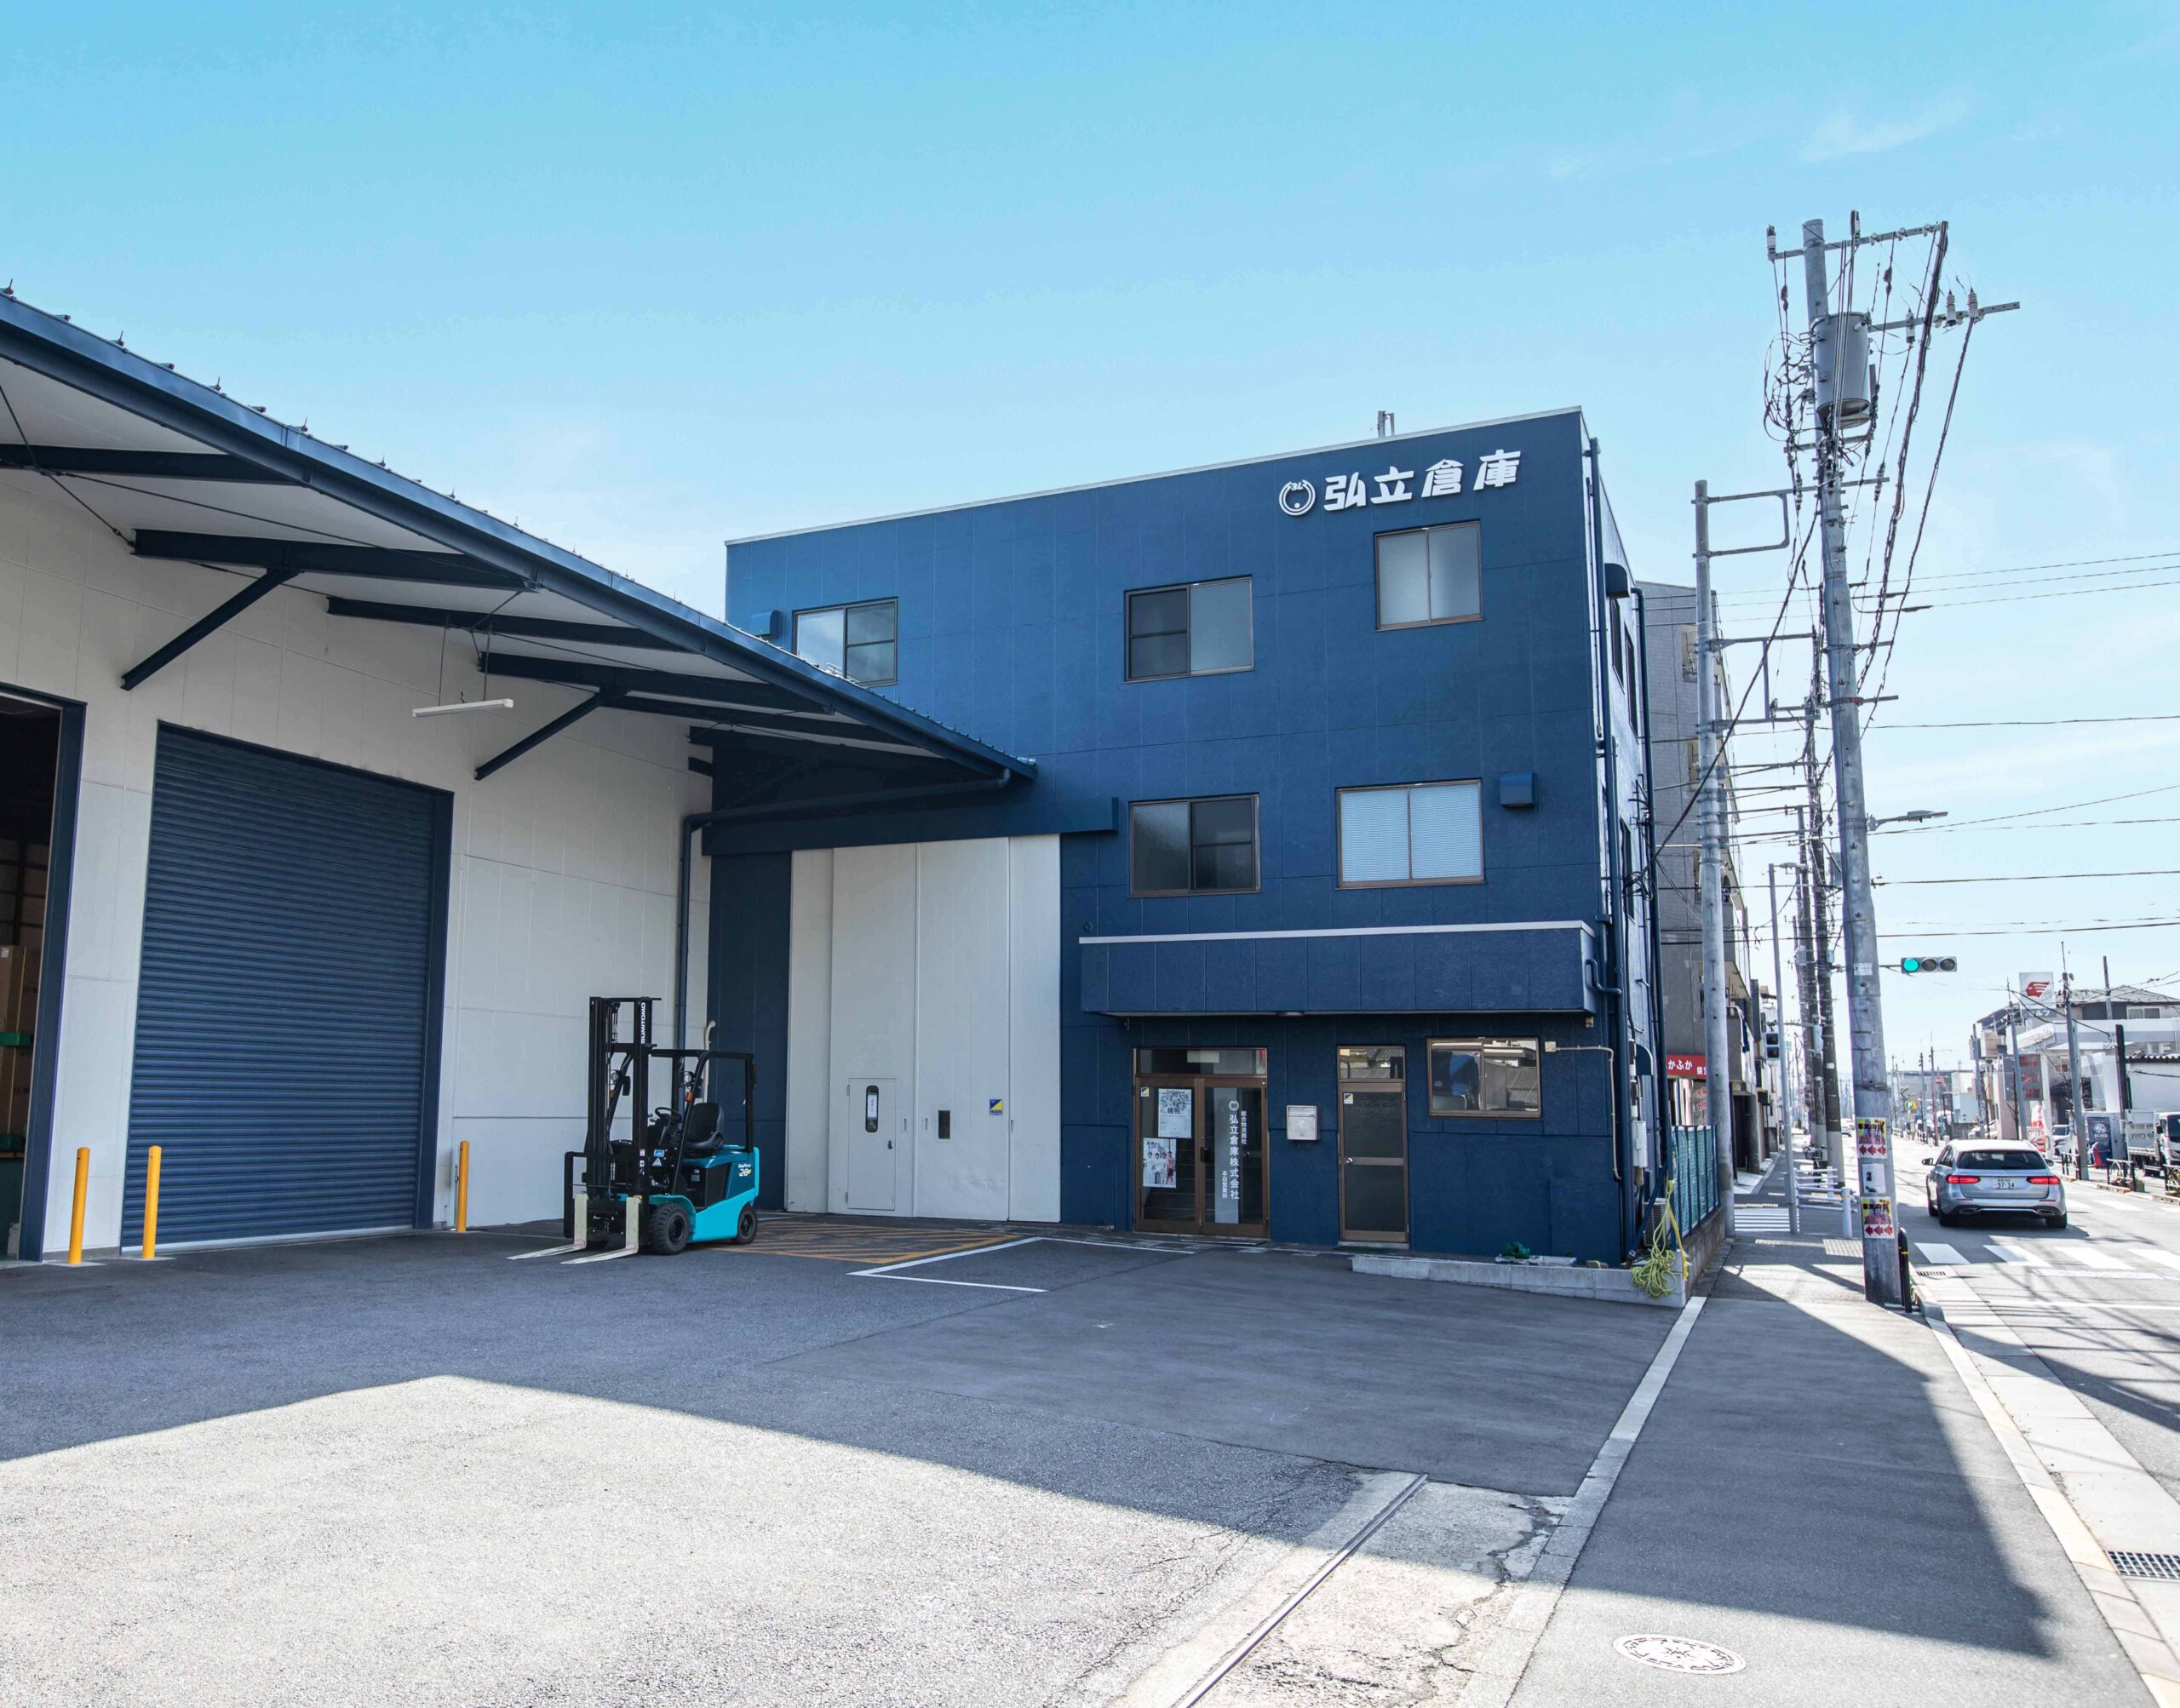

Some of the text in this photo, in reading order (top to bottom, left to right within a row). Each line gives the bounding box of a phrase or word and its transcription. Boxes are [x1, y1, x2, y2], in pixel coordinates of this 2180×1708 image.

[1323, 449, 1521, 512] 弘立倉庫
[1666, 1059, 1693, 1070] かふか
[1229, 1114, 1240, 1200] 弘立倉庫株式会社
